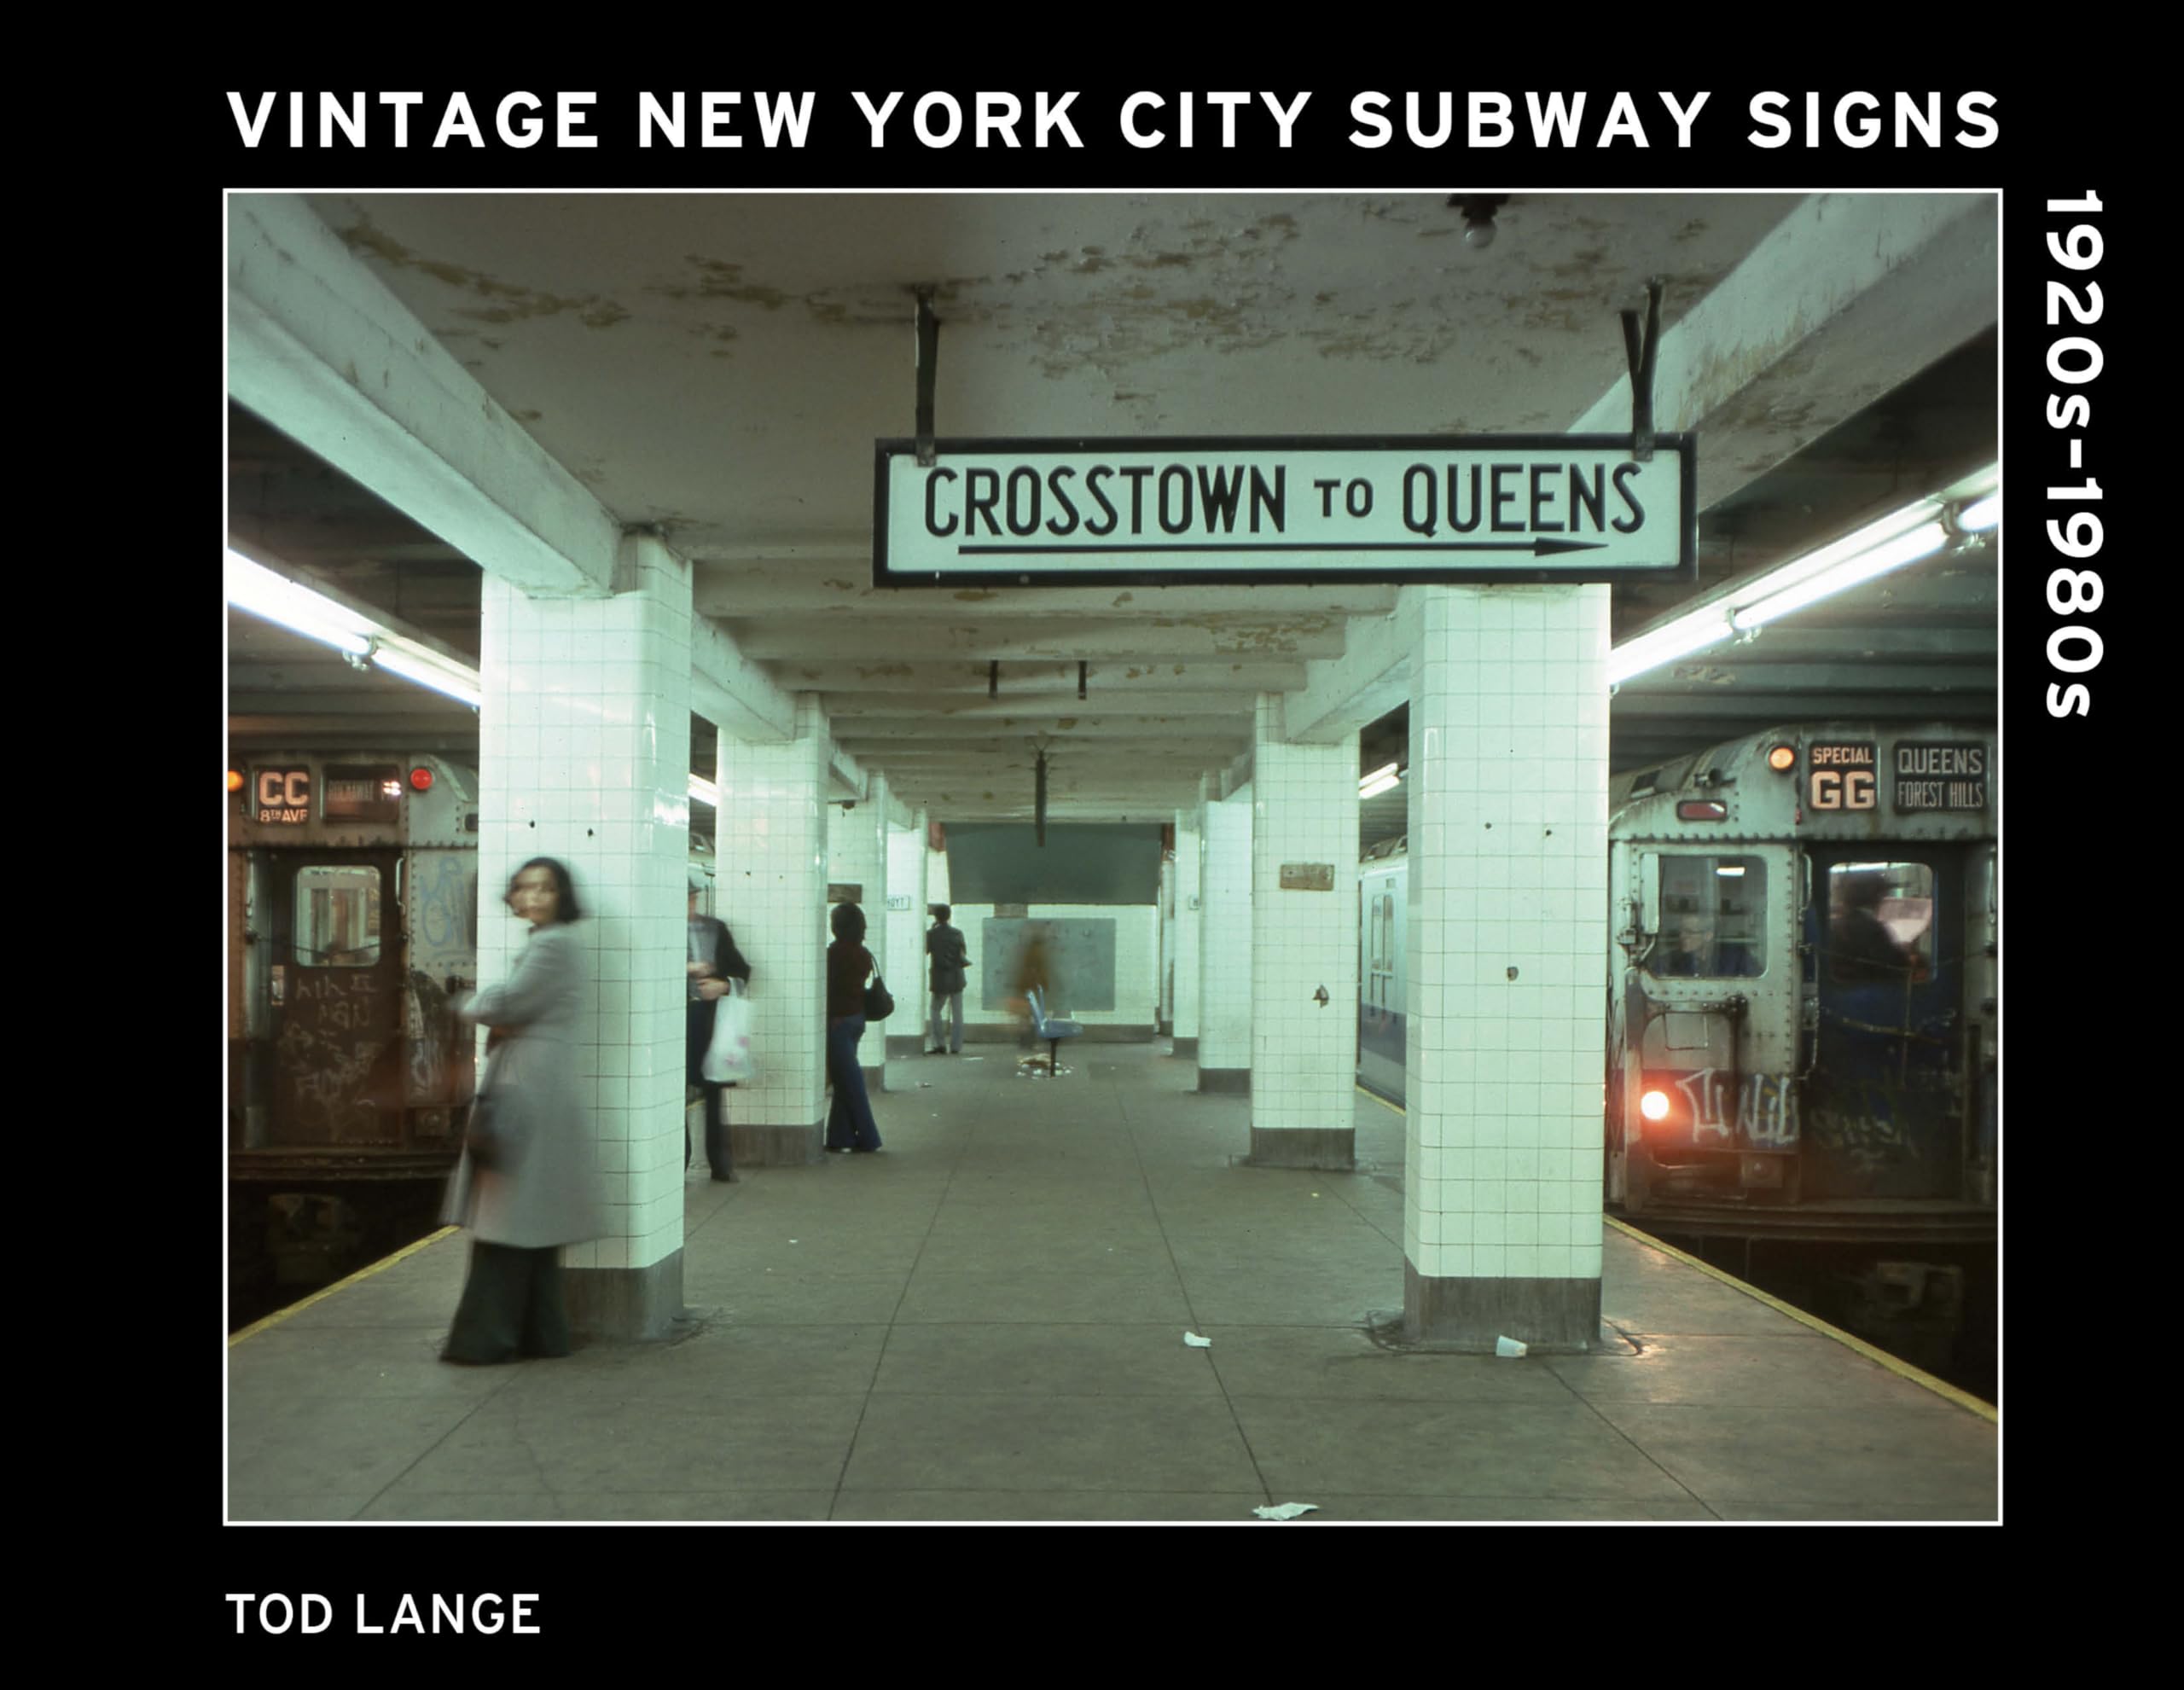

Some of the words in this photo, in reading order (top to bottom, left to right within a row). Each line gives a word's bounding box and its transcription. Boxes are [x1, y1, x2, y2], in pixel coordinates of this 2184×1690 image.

[925, 465, 1287, 537] CROSSTOWN
[1314, 479, 1374, 518] TO
[1403, 462, 1646, 537] QUEENS
[1813, 747, 1873, 765] SPECIAL
[1898, 748, 1983, 774] QUEENS
[259, 772, 309, 805] CC
[1811, 771, 1875, 809] GG
[1898, 781, 1945, 807] FOREST
[1949, 781, 1983, 807] HILLS
